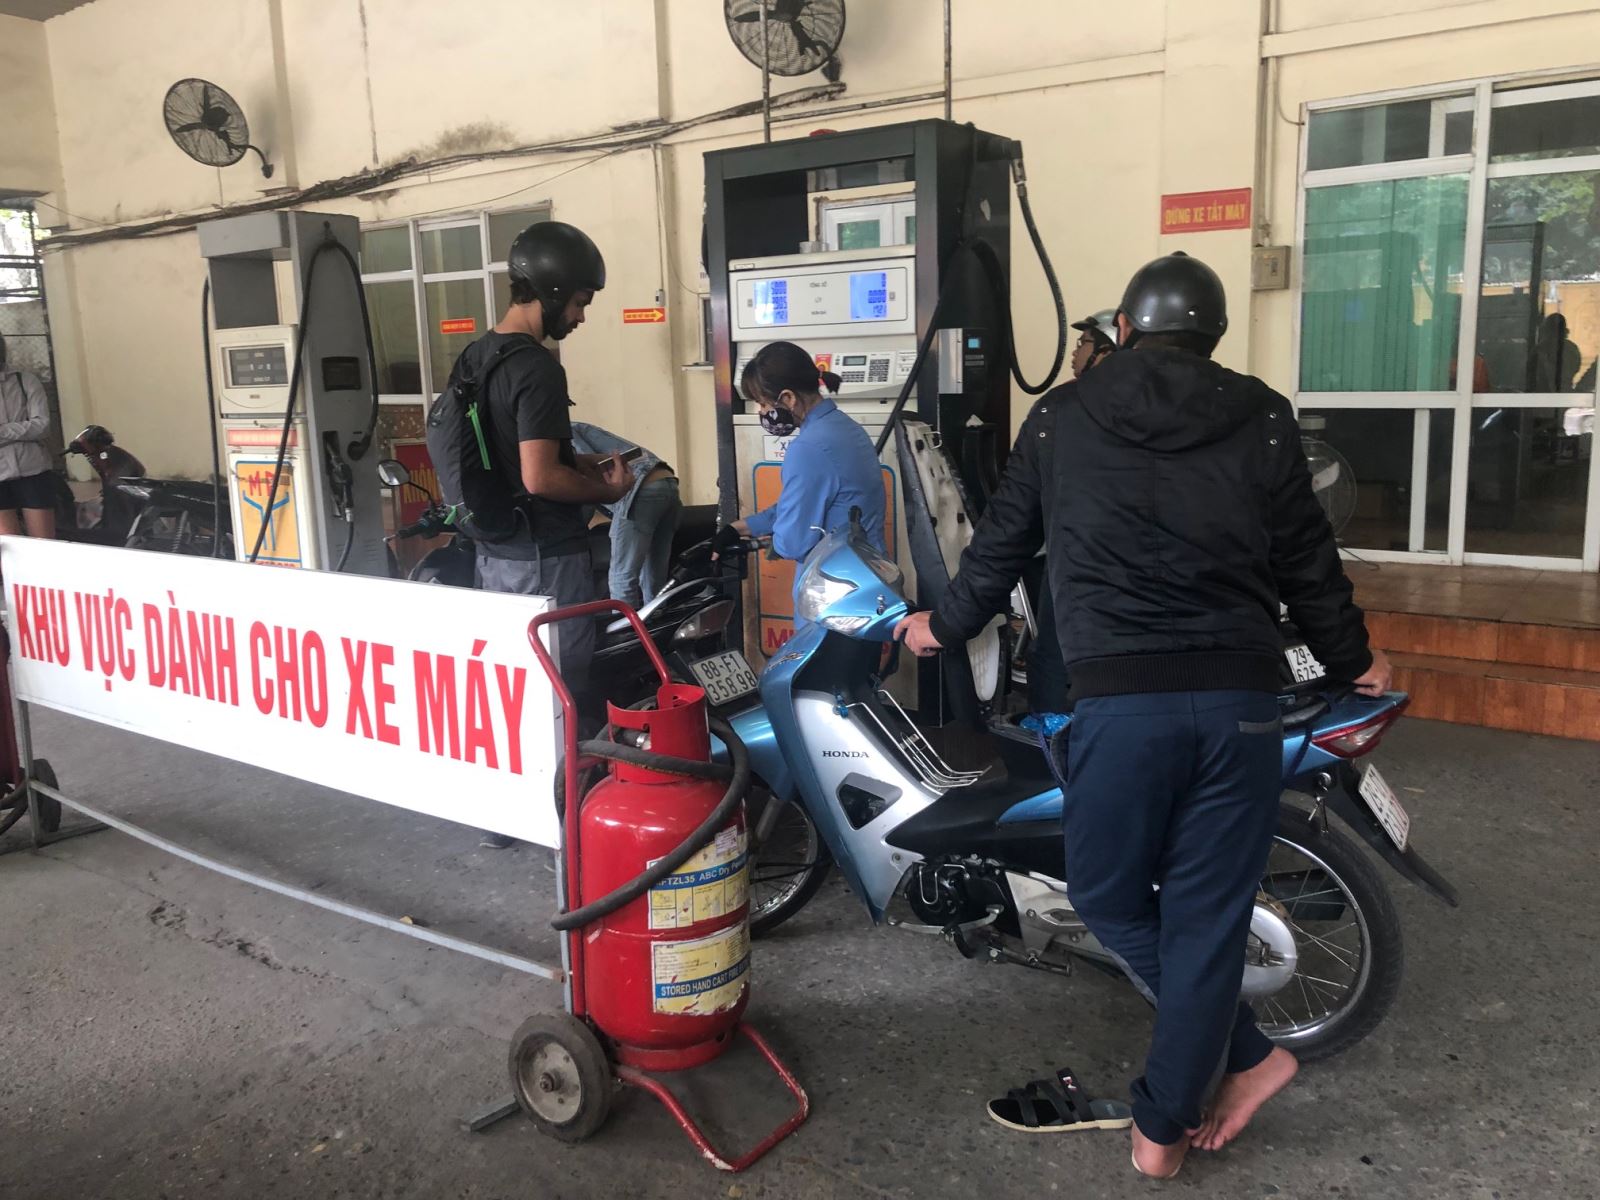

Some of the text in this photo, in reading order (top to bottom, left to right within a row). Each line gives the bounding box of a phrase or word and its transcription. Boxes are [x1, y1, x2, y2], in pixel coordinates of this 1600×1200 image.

[1192, 207, 1205, 223] XE
[1292, 647, 1311, 665] 29-
[700, 653, 741, 680] 88-F1
[13, 584, 527, 775] KHU VỰC DÀNH CHO XE MÁY
[707, 670, 757, 701] 358.98
[822, 750, 869, 758] HONDA
[699, 869, 718, 881] ABC
[661, 984, 691, 996] STORED
[692, 979, 711, 992] HAND
[712, 973, 728, 986] CART
